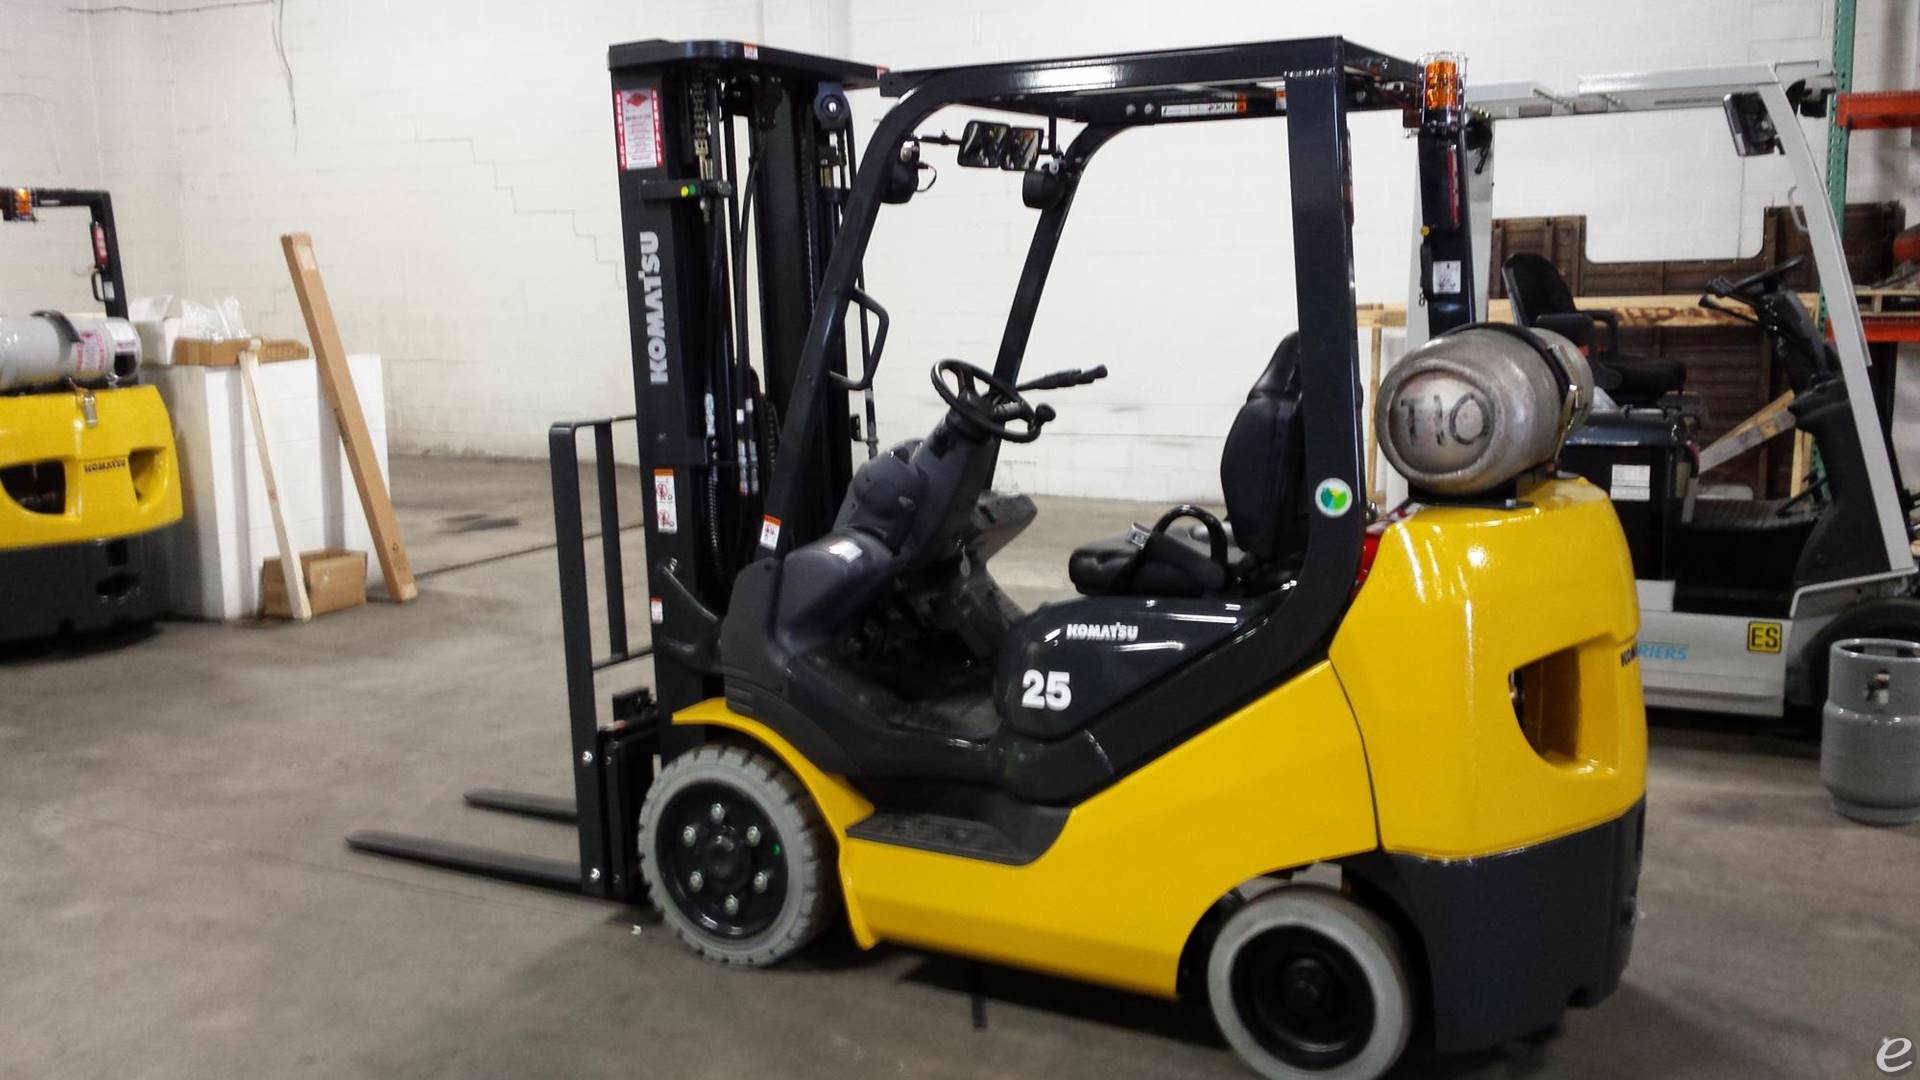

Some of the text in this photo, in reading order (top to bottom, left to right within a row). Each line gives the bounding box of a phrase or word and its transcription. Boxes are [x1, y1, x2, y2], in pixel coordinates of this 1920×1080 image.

[638, 231, 668, 384] KOMATSU
[84, 459, 126, 472] KOMATSU
[1066, 622, 1138, 640] KOMATSU
[1751, 627, 1778, 648] ES
[1022, 669, 1072, 711] 25
